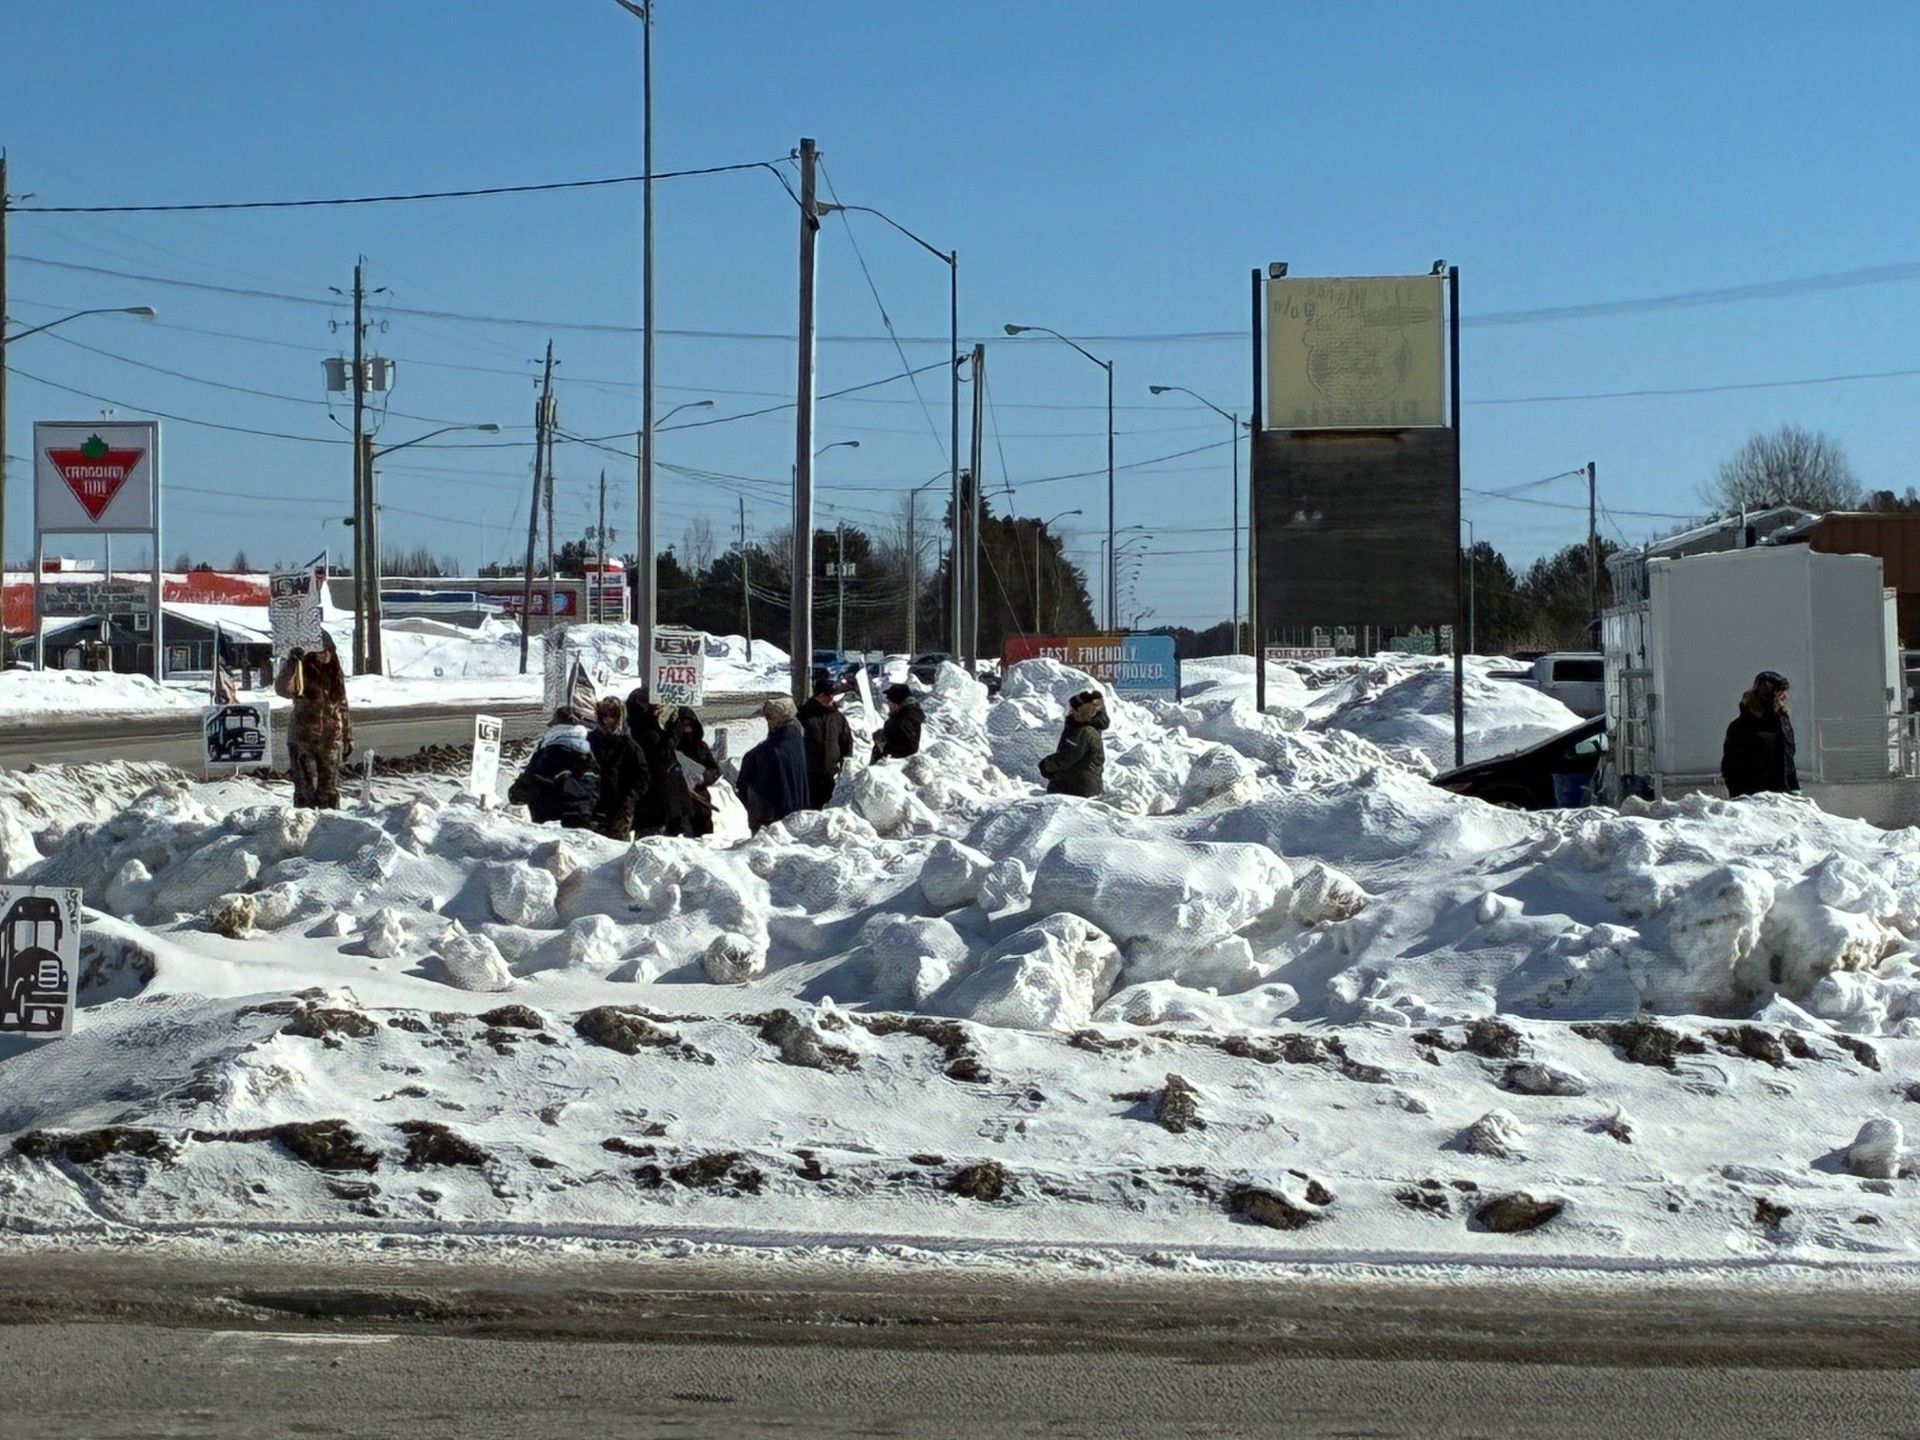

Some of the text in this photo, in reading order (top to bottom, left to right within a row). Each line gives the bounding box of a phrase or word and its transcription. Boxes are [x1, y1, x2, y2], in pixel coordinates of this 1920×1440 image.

[655, 637, 701, 655] USW
[1078, 646, 1137, 663] FRIENDLY
[658, 666, 697, 685] FAIR
[1098, 664, 1163, 680] APPROVED
